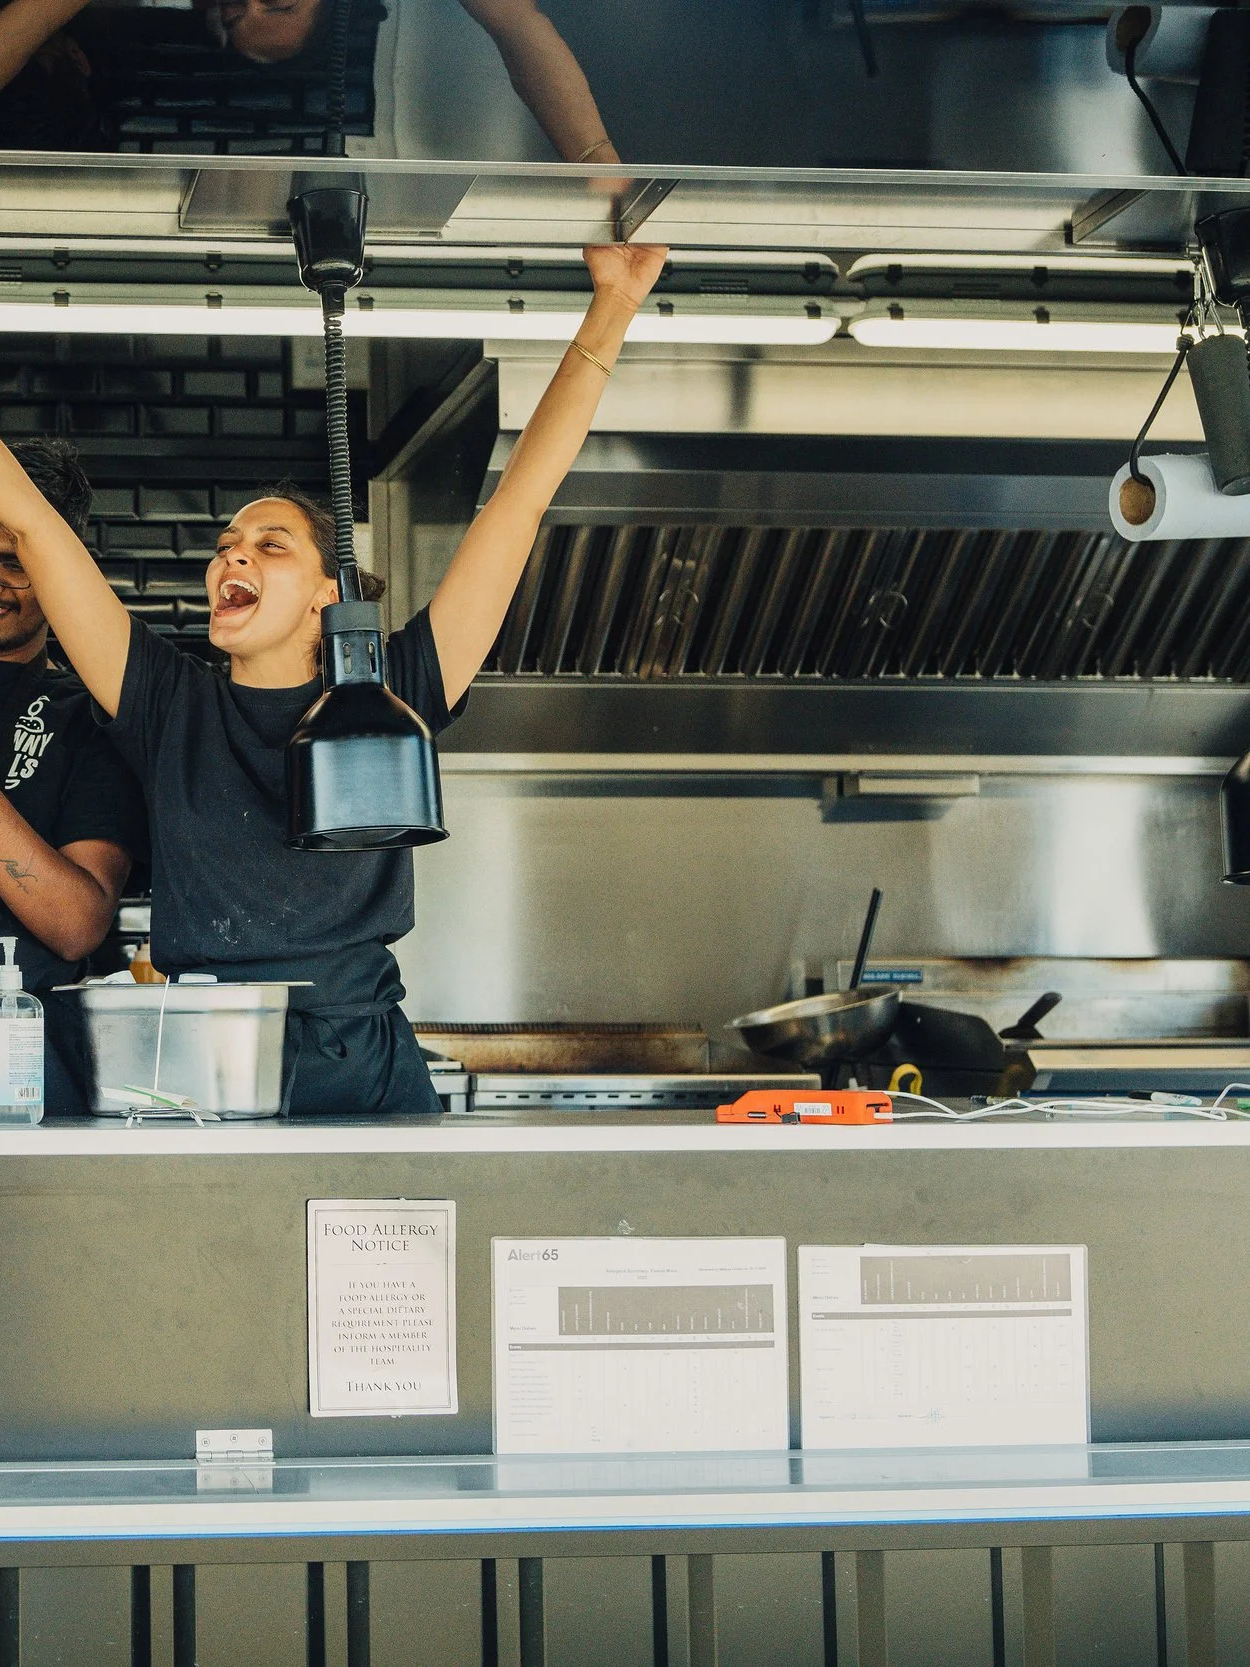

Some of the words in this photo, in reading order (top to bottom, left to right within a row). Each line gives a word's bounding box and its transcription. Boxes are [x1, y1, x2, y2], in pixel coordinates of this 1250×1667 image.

[324, 1223, 367, 1236] FOOD
[373, 1223, 439, 1236] ALLERGY
[351, 1239, 410, 1252] NOTICE
[508, 1249, 559, 1261] Alert65
[360, 1281, 379, 1289] YOU
[383, 1281, 406, 1289] HAVE
[339, 1294, 367, 1302] FOOD
[369, 1294, 409, 1302] ALLERGY
[411, 1293, 426, 1301] OR
[347, 1306, 383, 1315] SPECIAL
[387, 1305, 426, 1314] DIETARY
[331, 1320, 399, 1328] REQUIREMENT
[402, 1319, 434, 1327] PLEASE
[338, 1332, 377, 1340] INFORM
[388, 1331, 427, 1339] MEMBER
[371, 1344, 432, 1353] HOSPITALITY
[346, 1381, 392, 1393] THANK
[394, 1380, 422, 1392] YOU
